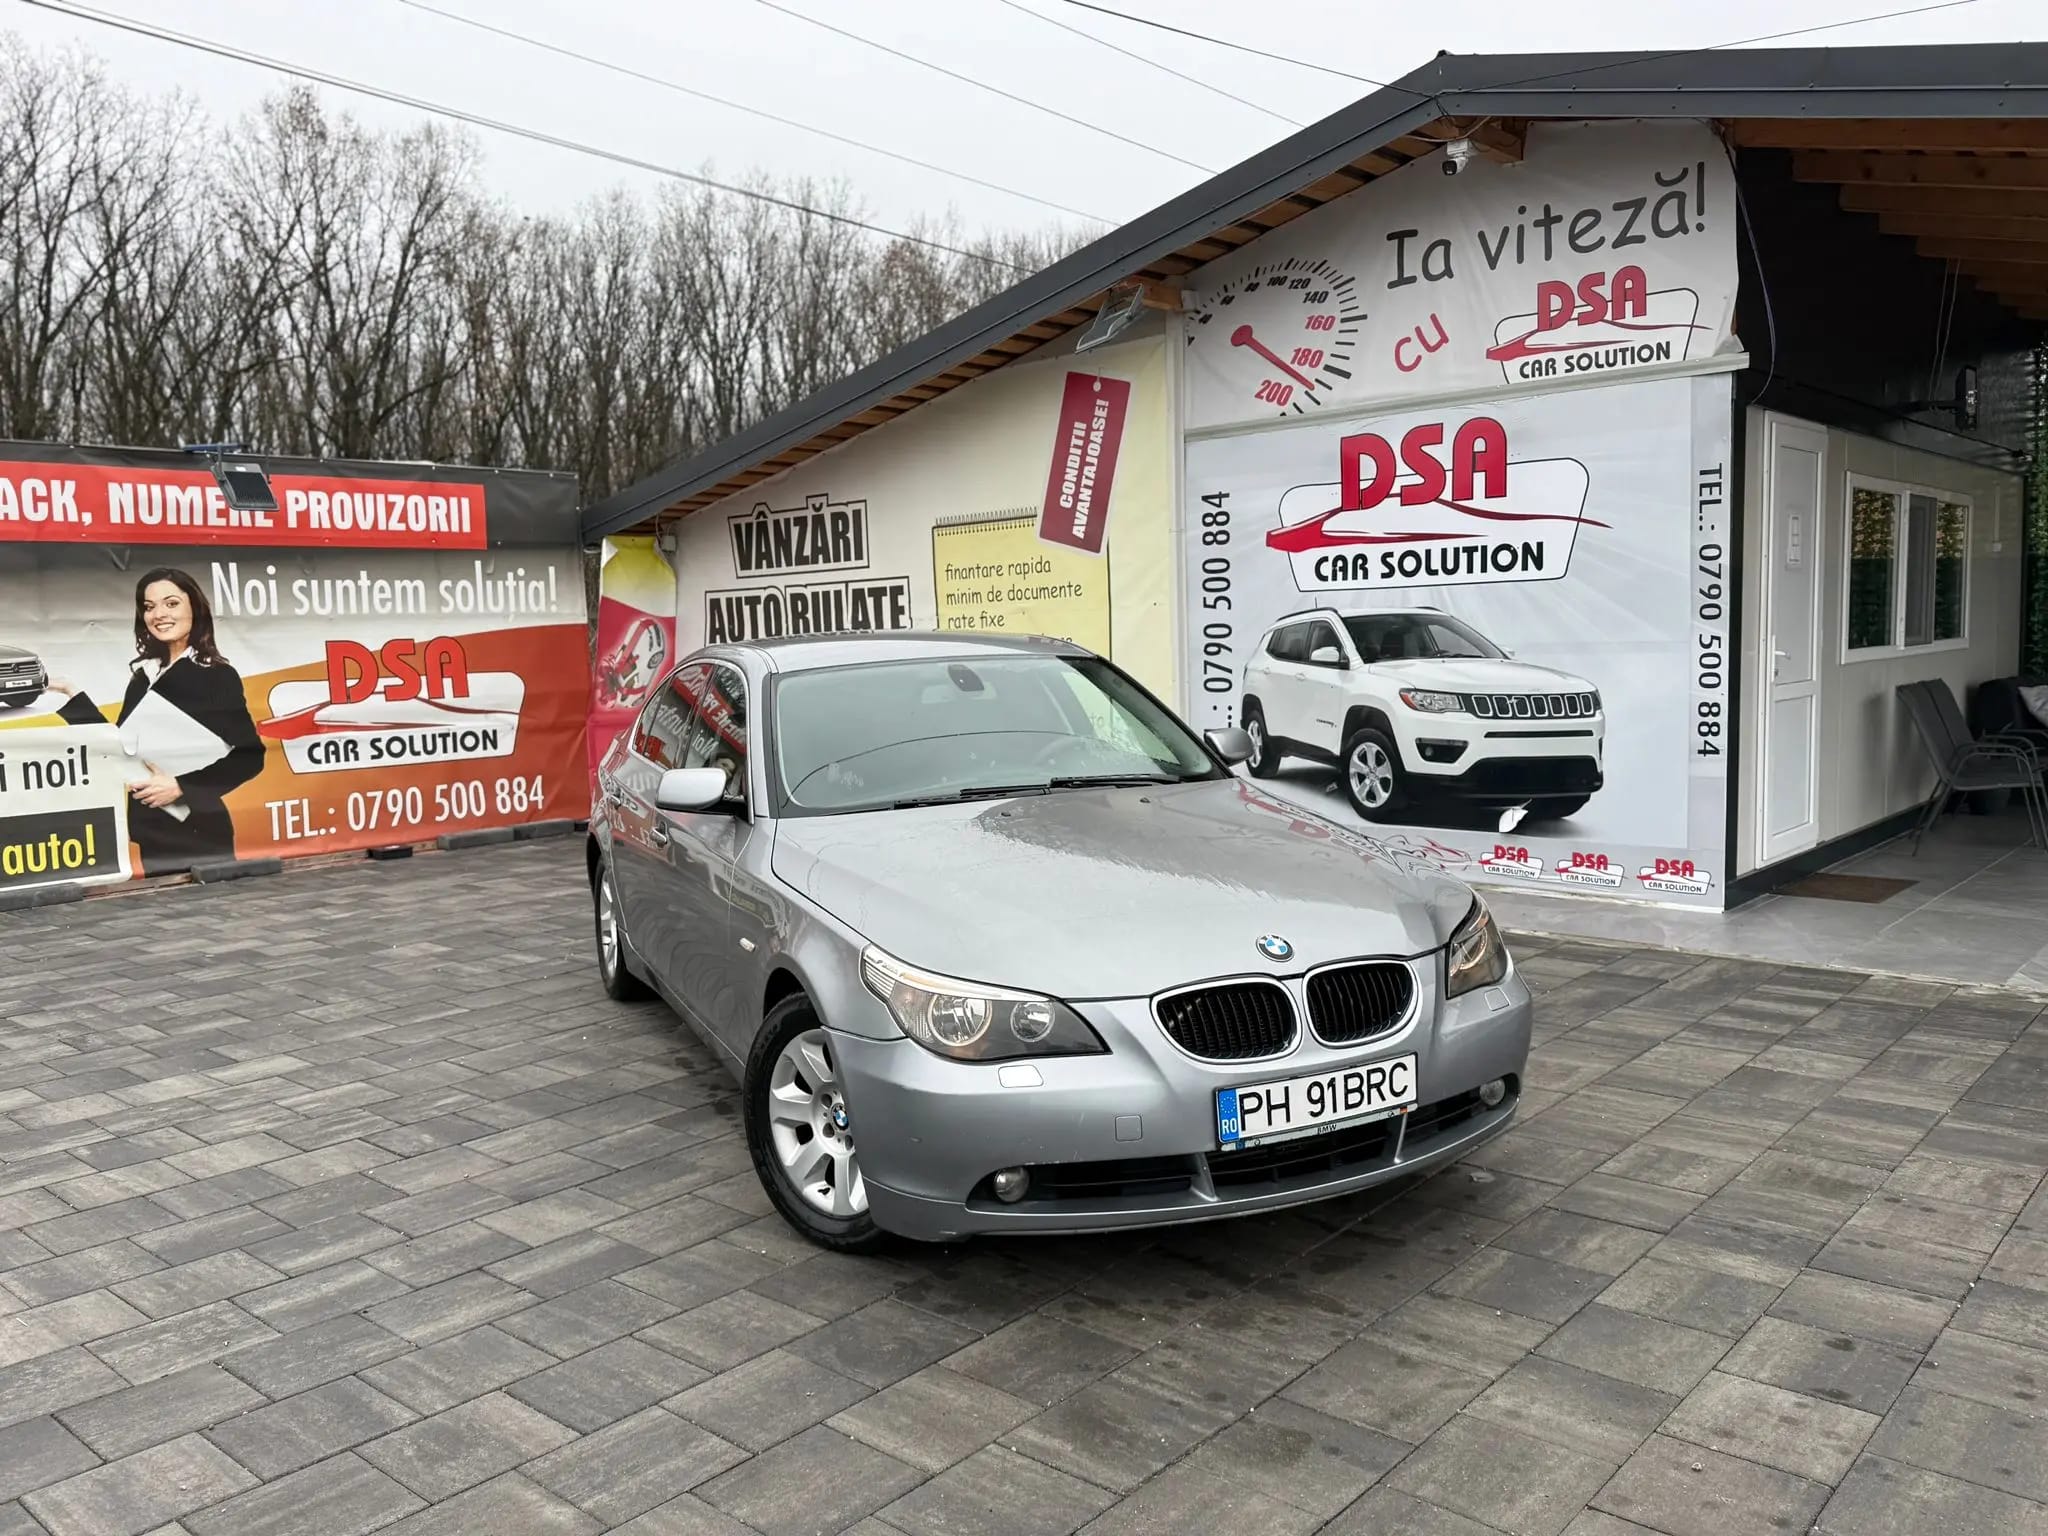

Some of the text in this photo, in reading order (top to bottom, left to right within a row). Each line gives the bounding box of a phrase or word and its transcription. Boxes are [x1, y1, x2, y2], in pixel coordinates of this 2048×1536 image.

[1386, 162, 1705, 289] Ia viteză!
[1288, 278, 1311, 289] 120
[1303, 291, 1329, 303] 140
[1537, 265, 1647, 331] DSA
[1304, 315, 1336, 331] 160
[1395, 313, 1449, 372] cu
[1290, 348, 1324, 368] 180
[1519, 341, 1671, 379] CAR SOLUTION
[1254, 379, 1294, 406] 200
[1060, 421, 1087, 509] CONDITII
[1072, 399, 1110, 539] AVANTAJOASE!
[1340, 417, 1508, 511] DSA
[107, 482, 274, 528] NUME
[285, 489, 472, 533] PROVIZORII
[1201, 491, 1231, 546] 884
[733, 502, 864, 571] VÂNZĂRI
[945, 556, 1051, 581] finantare rapida
[1202, 558, 1232, 610] 500
[1315, 542, 1544, 582] CAR SOLUTION
[211, 560, 558, 622] Noi suntem soluția!
[946, 582, 1082, 606] minim de documente
[1697, 462, 1722, 757] TEL.: 0790 500 884
[709, 593, 783, 644] AUTO
[948, 611, 1005, 630] rate fixe
[325, 636, 470, 704] DSA
[1203, 623, 1233, 693] 0790
[23, 745, 90, 790] noi!
[307, 729, 498, 765] CAR SOLUTION
[265, 774, 545, 841] TEL.: 0790 500 884
[3, 824, 96, 876] auto!
[1494, 845, 1529, 863] DSA
[1502, 867, 1535, 878] SOLUTION
[1572, 852, 1609, 871] DSA
[1655, 858, 1694, 877] DSA
[1581, 875, 1616, 886] SOLUTION
[1664, 883, 1702, 893] SOLUTION
[1223, 1119, 1238, 1135] RO
[1238, 1085, 1291, 1131] PH
